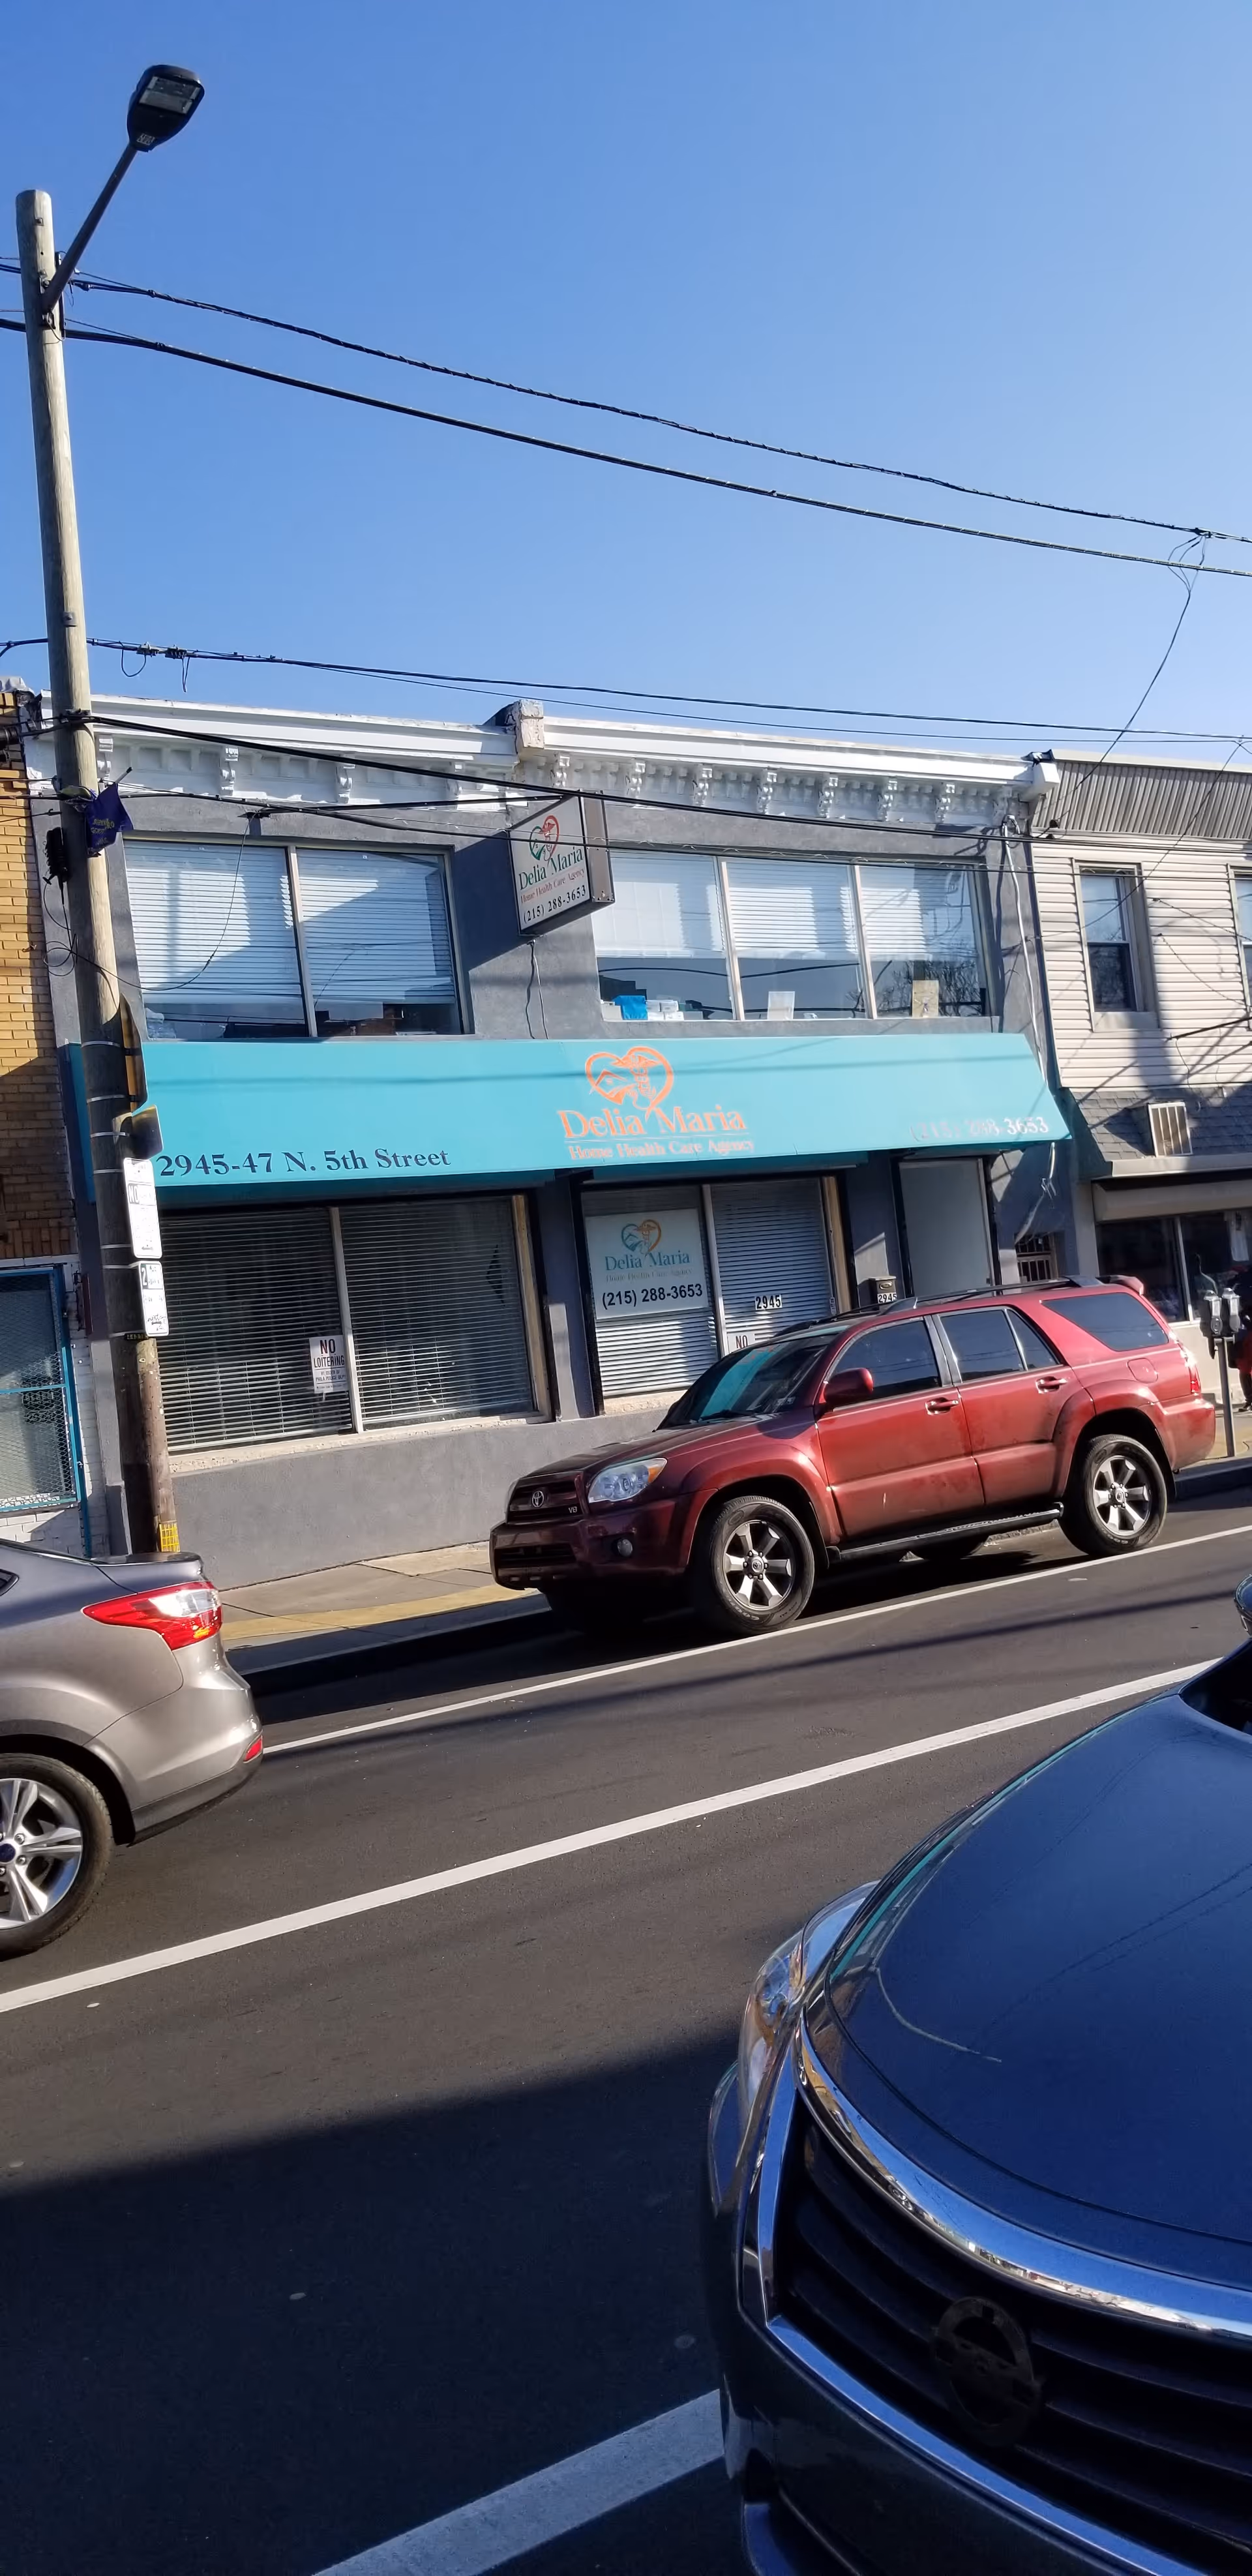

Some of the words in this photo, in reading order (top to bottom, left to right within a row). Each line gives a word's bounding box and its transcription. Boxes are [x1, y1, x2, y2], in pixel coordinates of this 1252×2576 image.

[519, 865, 546, 890] Delia
[550, 846, 584, 875] Maria
[536, 882, 552, 897] Health
[553, 878, 565, 888] Care
[524, 905, 544, 923] (215)
[548, 885, 586, 912] 288-3653
[557, 1108, 646, 1138] Delia
[654, 1104, 747, 1133] Maria
[569, 1145, 614, 1160] Home
[618, 1141, 666, 1158] Health
[668, 1140, 702, 1154] Care
[156, 1152, 273, 1176] 2945-47
[282, 1151, 316, 1172] N.
[324, 1149, 368, 1171] 5th
[374, 1146, 451, 1169] Street
[604, 1254, 642, 1271] Delia
[649, 1250, 690, 1267] Maria
[603, 1290, 637, 1310] (215)
[641, 1283, 703, 1302] 288-3653
[756, 1295, 781, 1310] 2945
[878, 1293, 897, 1303] 2945
[320, 1339, 336, 1355] NO
[736, 1335, 748, 1349] NO
[313, 1355, 345, 1368] LOITERING
